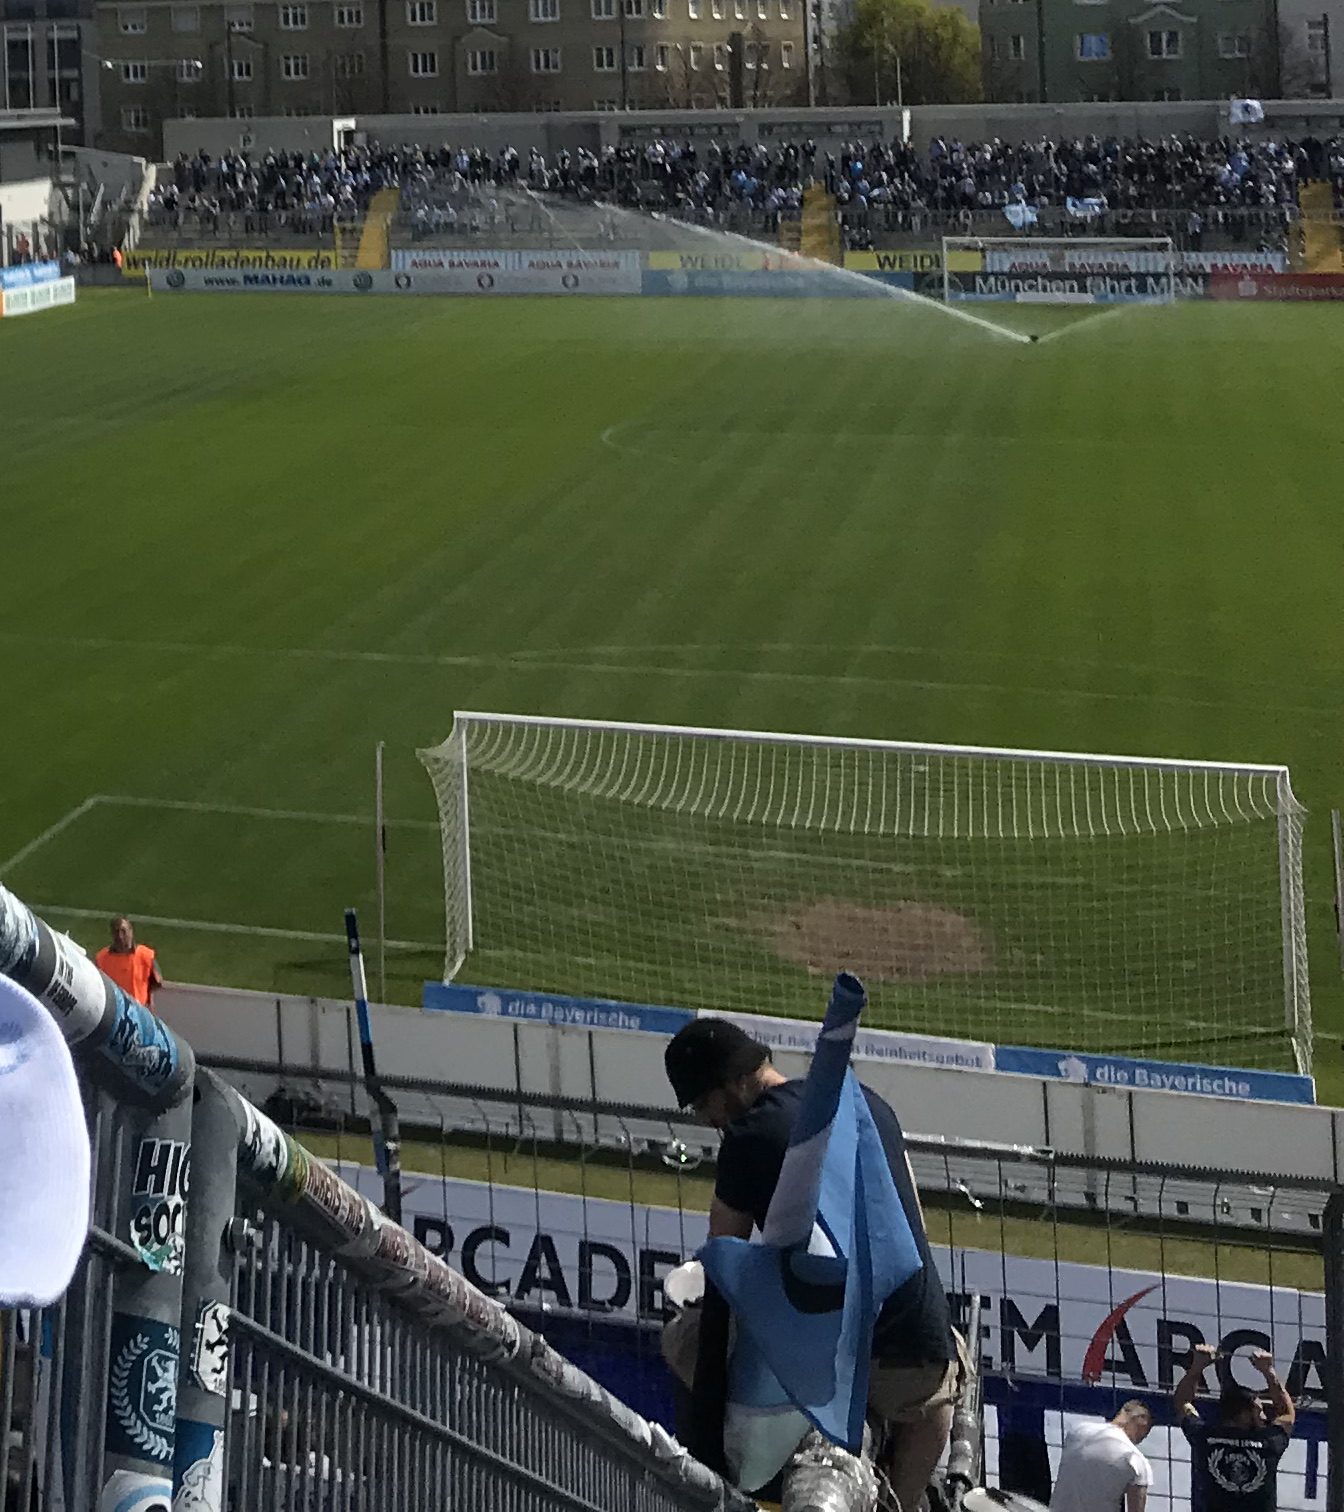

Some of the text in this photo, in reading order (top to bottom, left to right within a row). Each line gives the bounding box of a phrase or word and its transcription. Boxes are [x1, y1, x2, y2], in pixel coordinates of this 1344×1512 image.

[409, 258, 500, 270] AQUA BAVARIA
[974, 274, 1079, 293] München
[1146, 275, 1206, 296] MAN
[508, 996, 642, 1031] die Bayerische
[1095, 1063, 1251, 1096] die Bayerische
